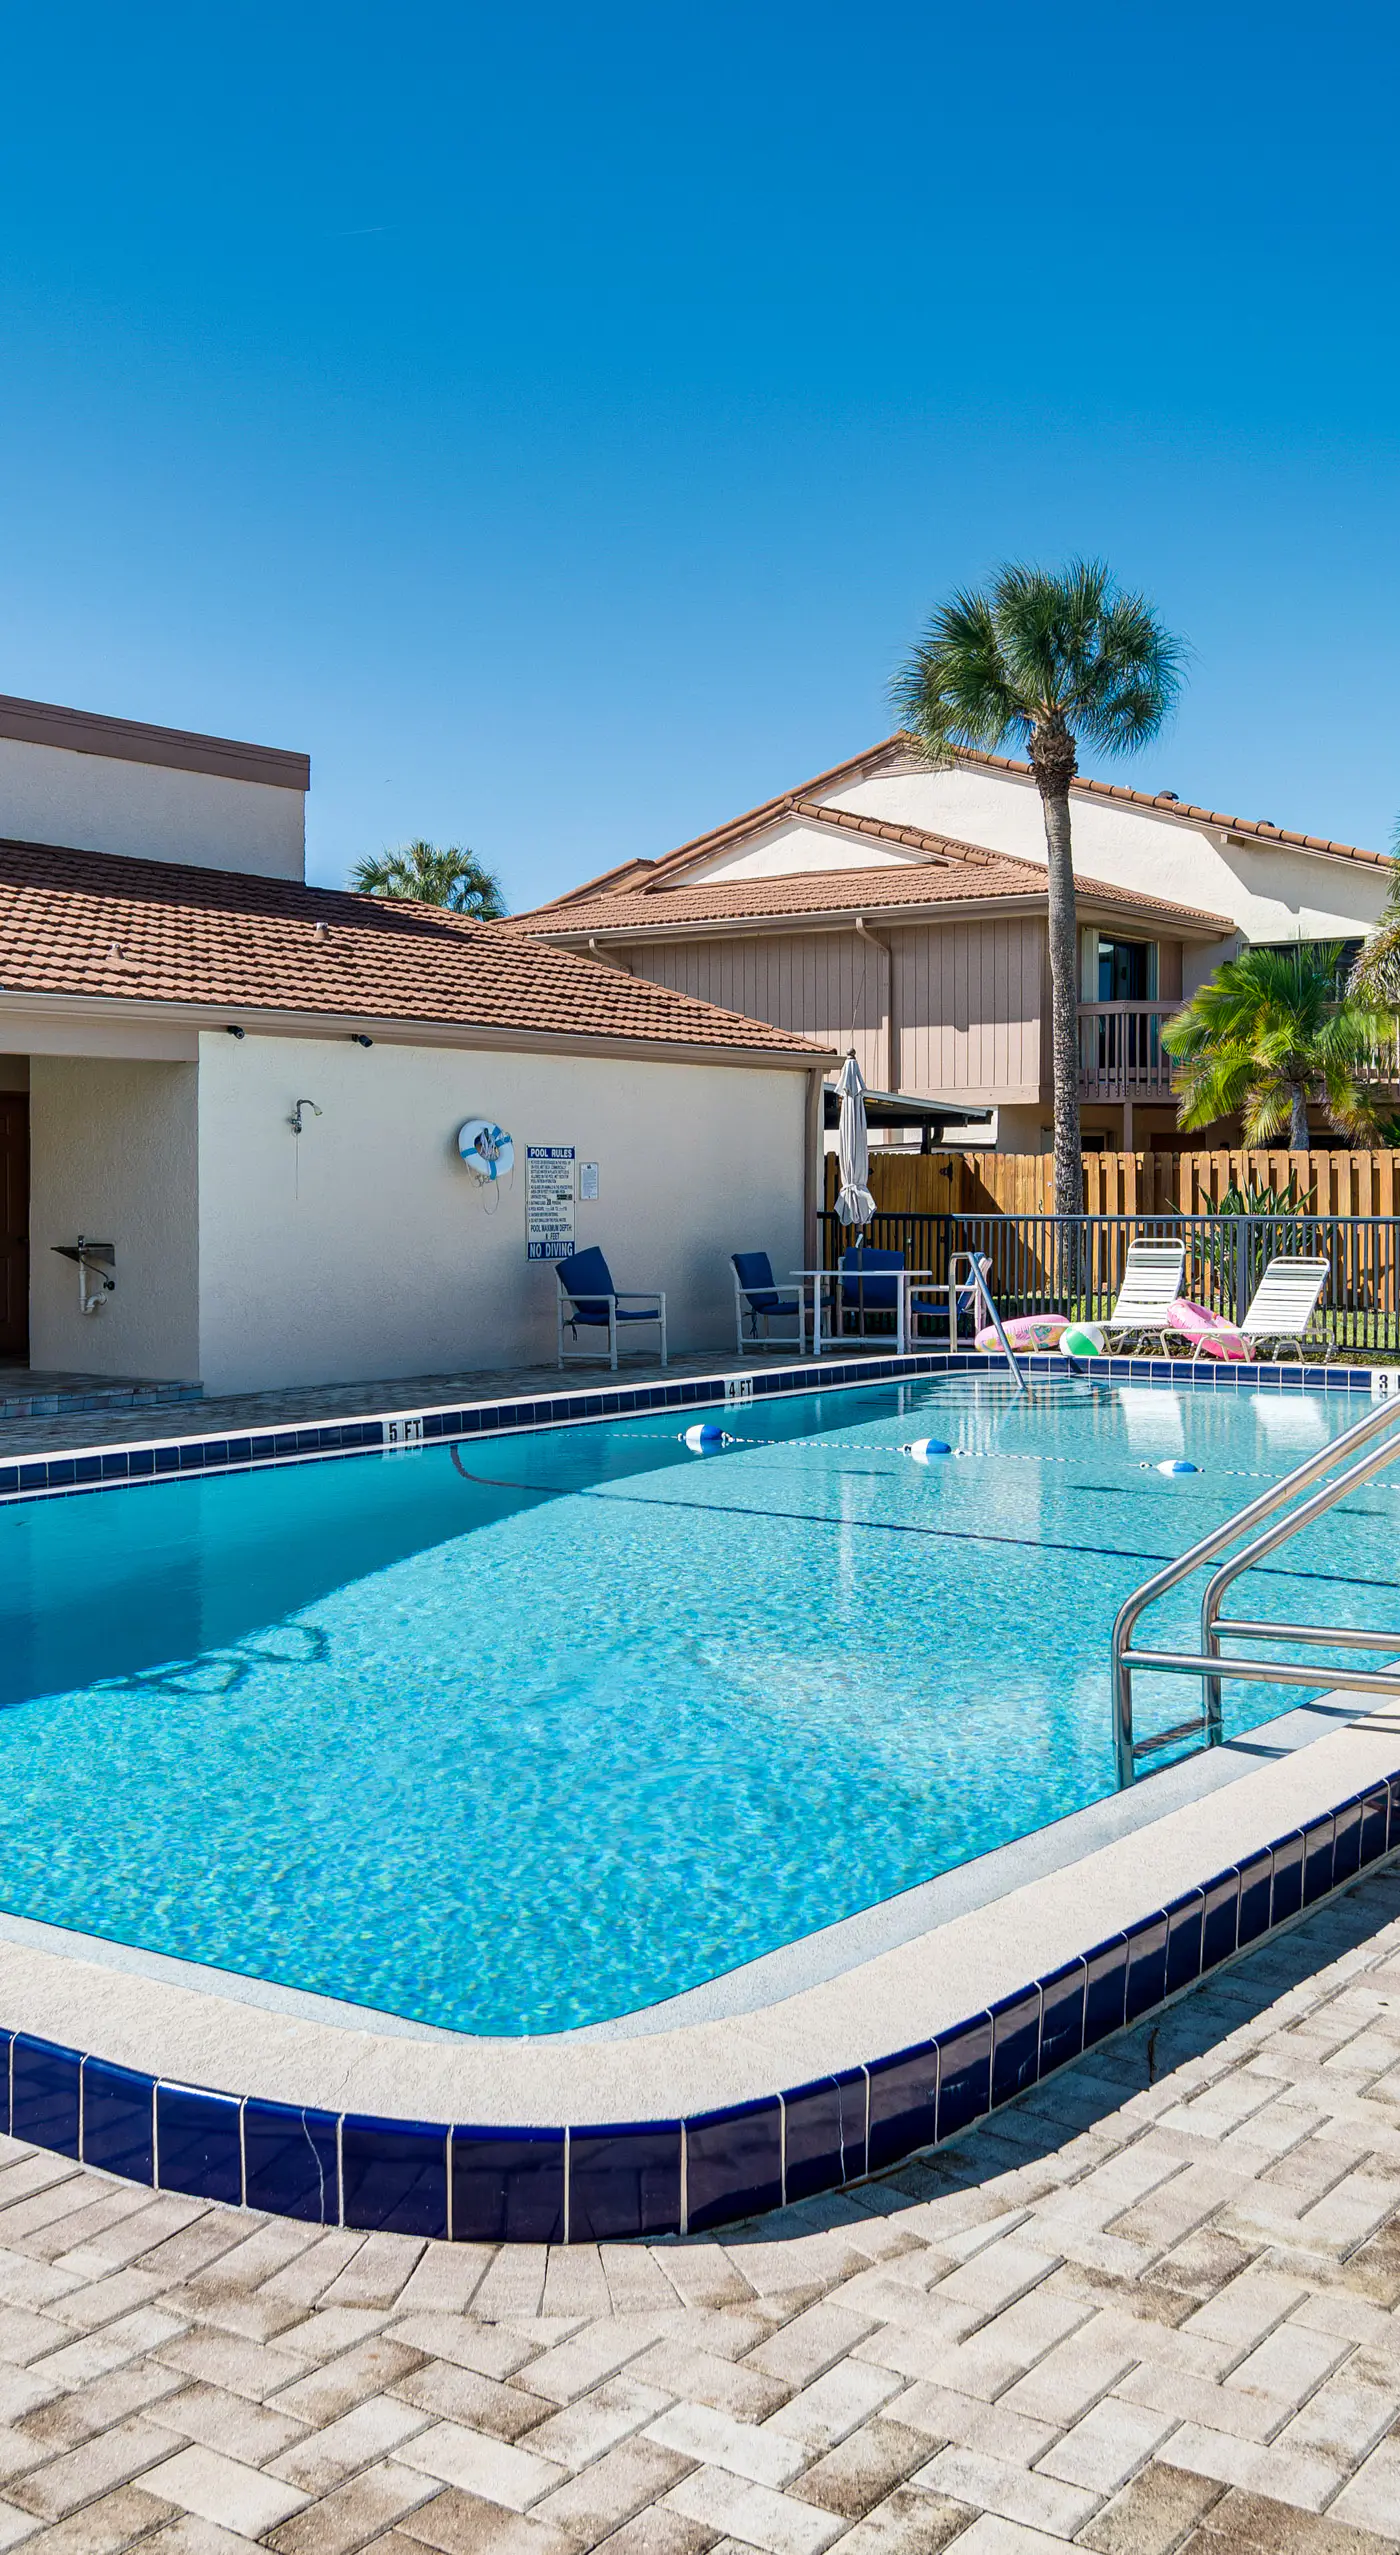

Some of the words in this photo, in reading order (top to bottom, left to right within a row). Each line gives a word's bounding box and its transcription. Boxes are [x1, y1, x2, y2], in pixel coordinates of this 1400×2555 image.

[531, 1149, 548, 1157] POOL
[552, 1149, 572, 1158] RULES
[530, 1243, 541, 1257] NO
[546, 1242, 573, 1257] DIVING
[729, 1381, 735, 1397] 4
[1379, 1374, 1388, 1391] 3
[389, 1422, 397, 1442] 5
